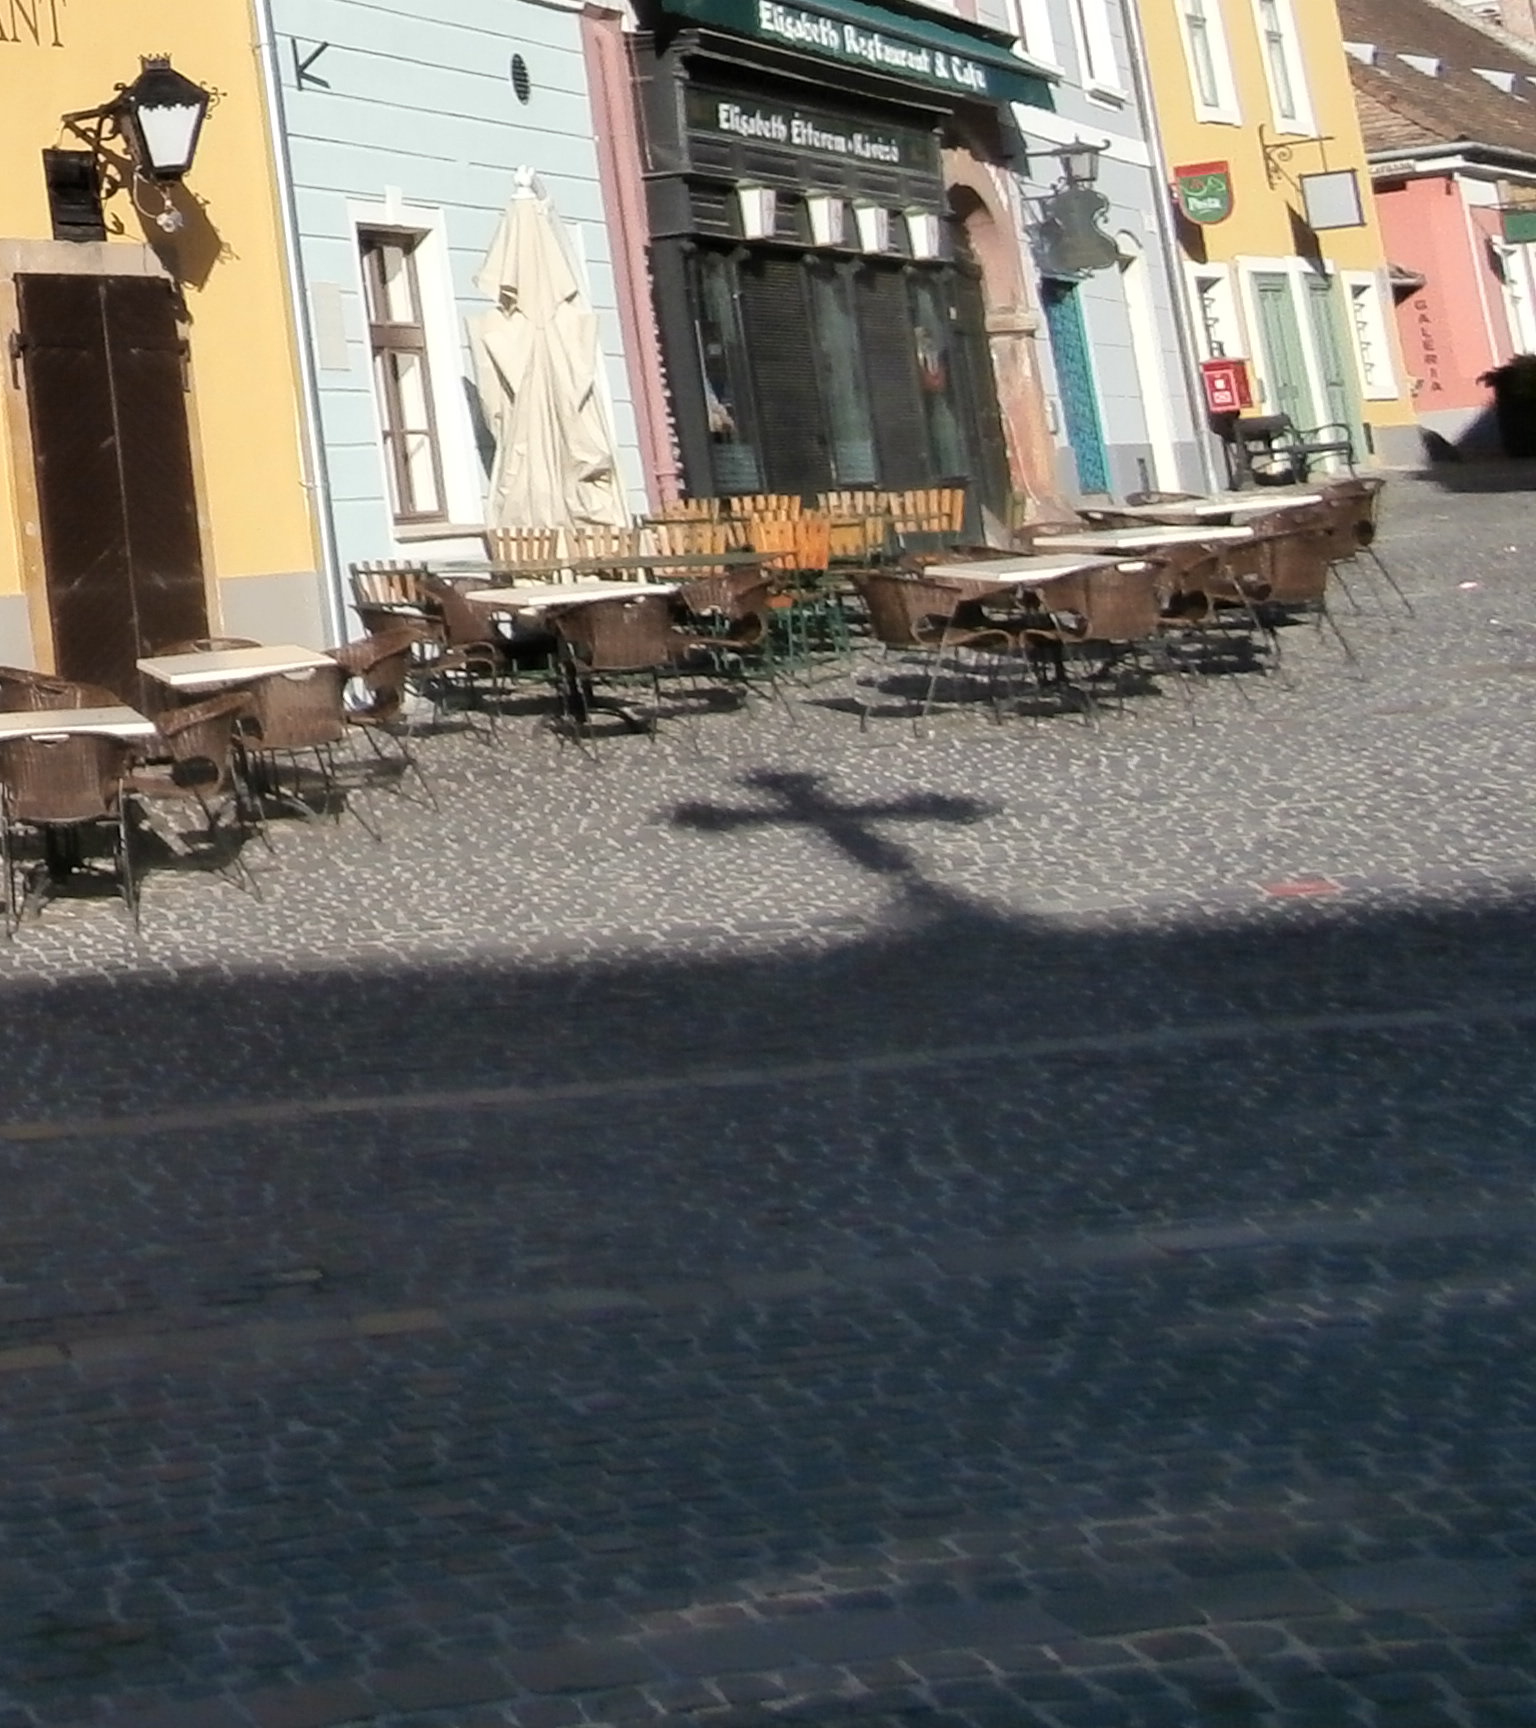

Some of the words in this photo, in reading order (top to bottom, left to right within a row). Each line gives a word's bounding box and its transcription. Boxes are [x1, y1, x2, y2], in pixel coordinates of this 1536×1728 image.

[757, 0, 840, 51] Elisabeth
[843, 23, 932, 74] Restaurant
[934, 51, 950, 79] &
[717, 102, 788, 142] Elisabeth
